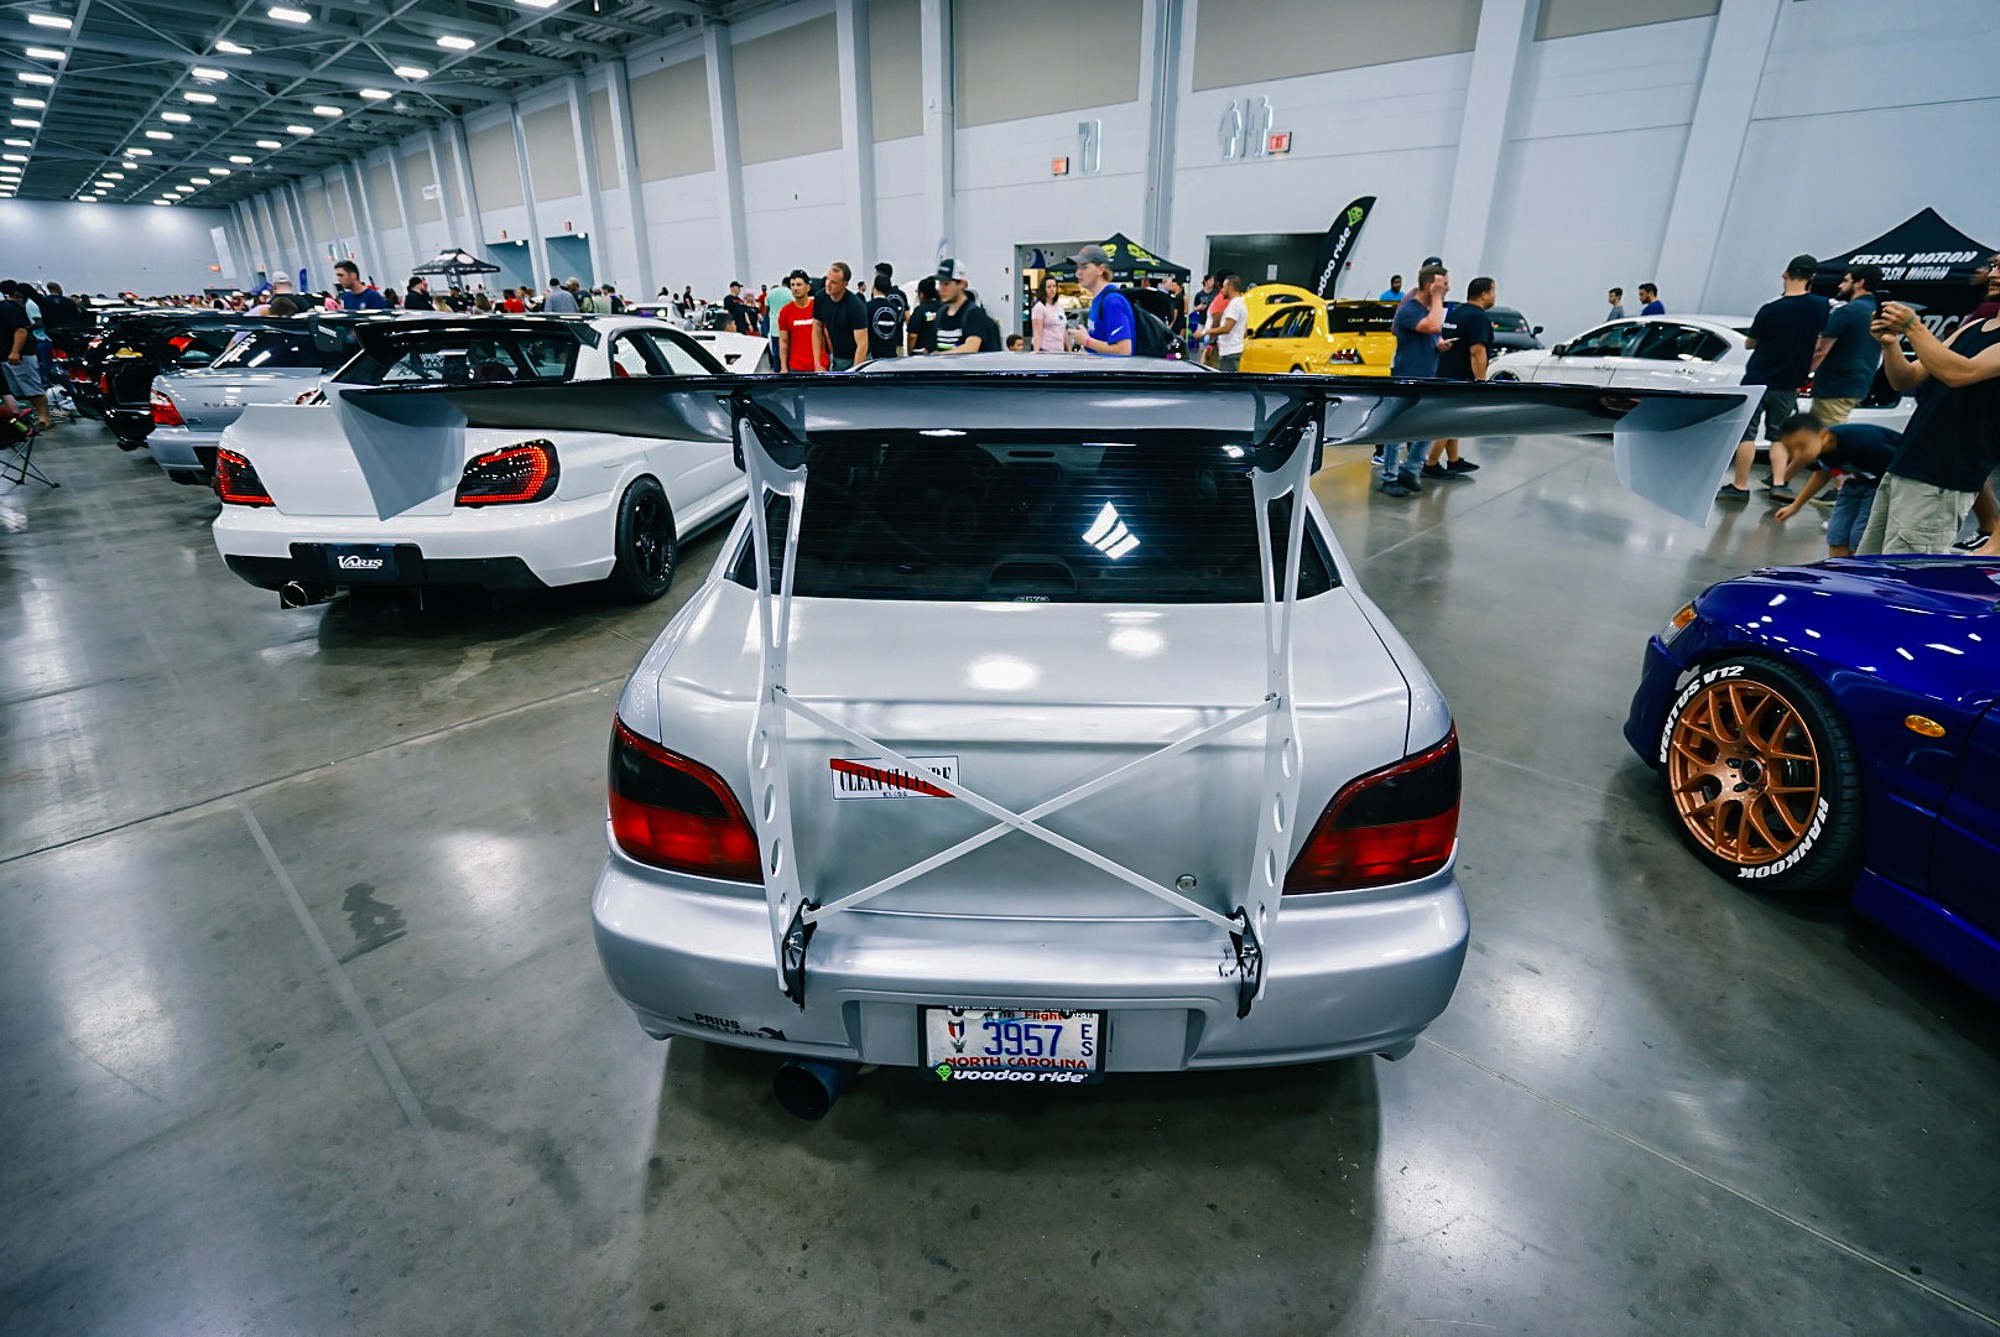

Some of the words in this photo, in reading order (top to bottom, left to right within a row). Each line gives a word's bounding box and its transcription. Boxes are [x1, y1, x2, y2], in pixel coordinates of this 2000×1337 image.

[1317, 259, 1336, 297] odoo
[1333, 227, 1351, 260] ride
[1907, 251, 1978, 264] NATION
[1905, 266, 1950, 281] NATION
[1660, 677, 1701, 764] VENTUS
[1703, 665, 1745, 684] V12
[840, 769, 882, 791] CLEAN
[1738, 797, 1829, 878] HANKOOK
[694, 1012, 741, 1030] PRIUS
[982, 1021, 1063, 1058] 3957
[945, 1056, 1001, 1068] NORTH
[1006, 1057, 1088, 1069] CAROLINA
[953, 1069, 1036, 1082] voodoo
[1038, 1072, 1085, 1083] ride
